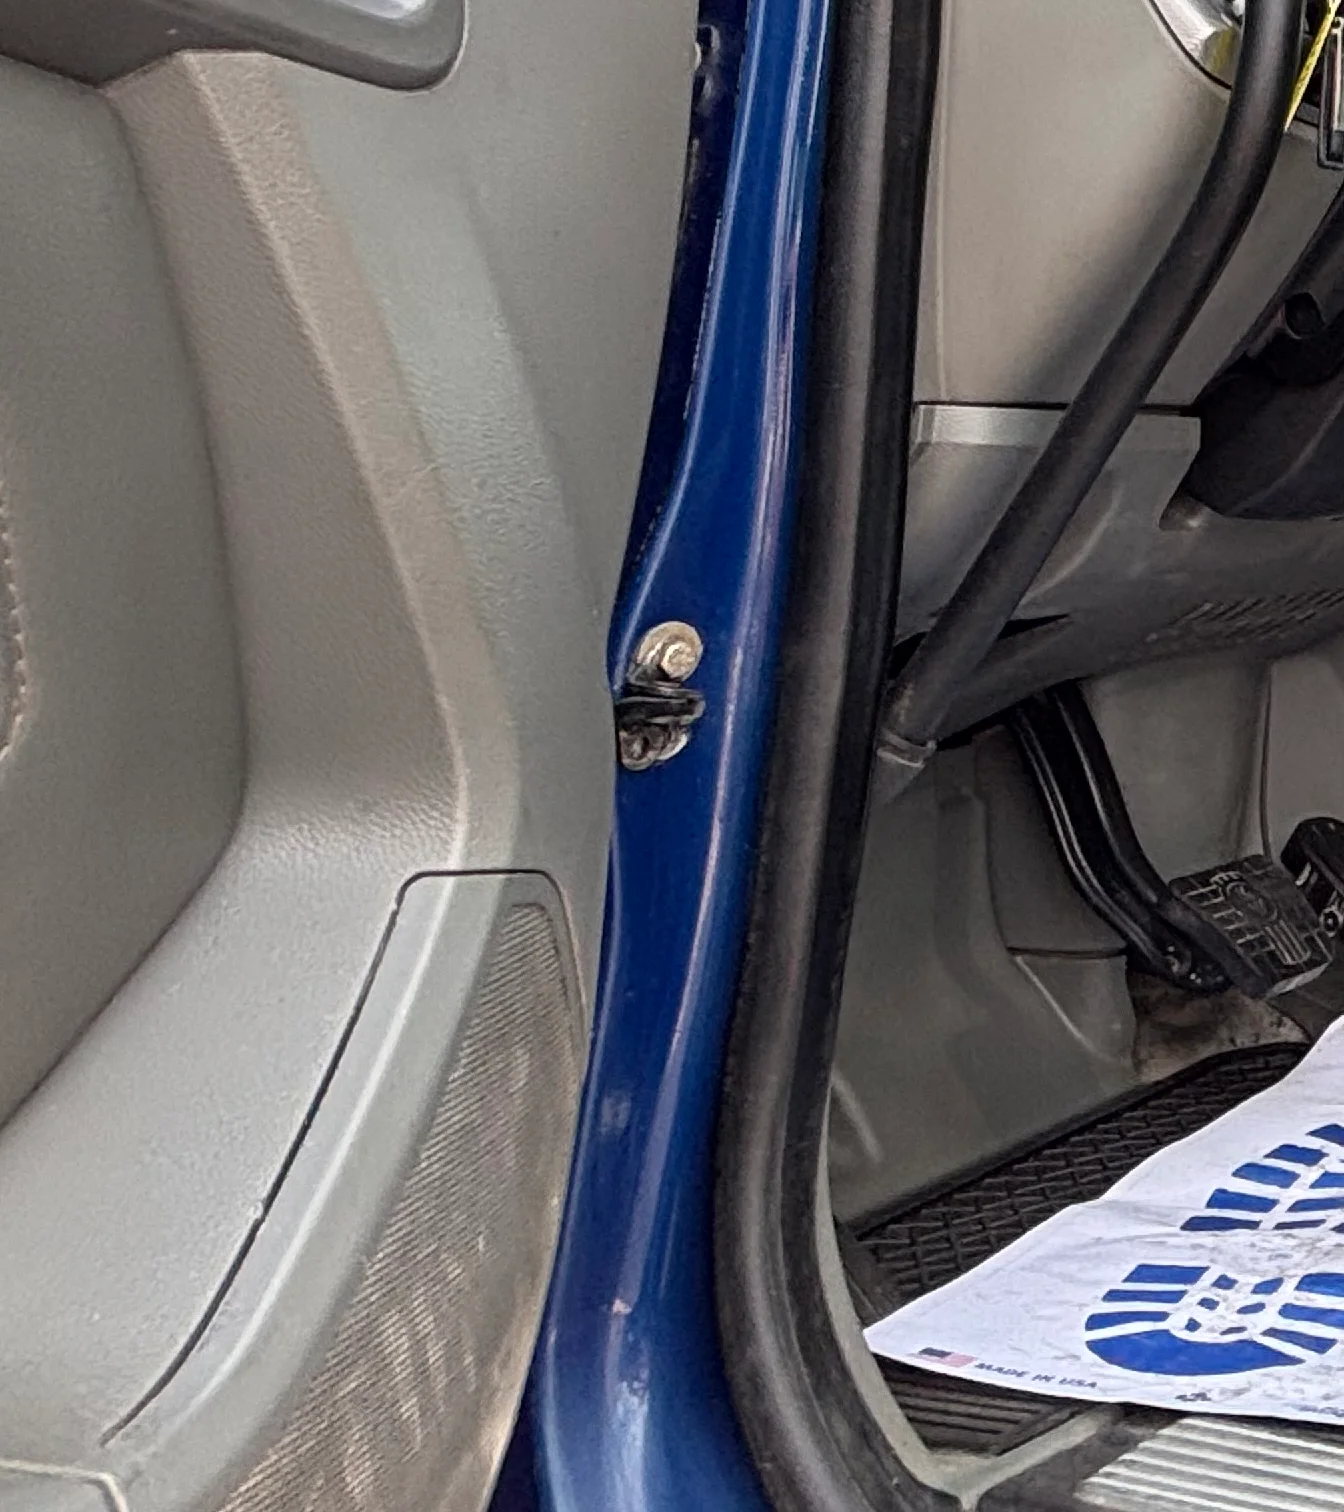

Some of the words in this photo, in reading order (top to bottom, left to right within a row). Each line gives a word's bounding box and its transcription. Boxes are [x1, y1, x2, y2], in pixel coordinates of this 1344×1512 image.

[974, 1362, 1030, 1378] MADE
[1031, 1374, 1056, 1383] IN
[1058, 1377, 1098, 1389] USA
